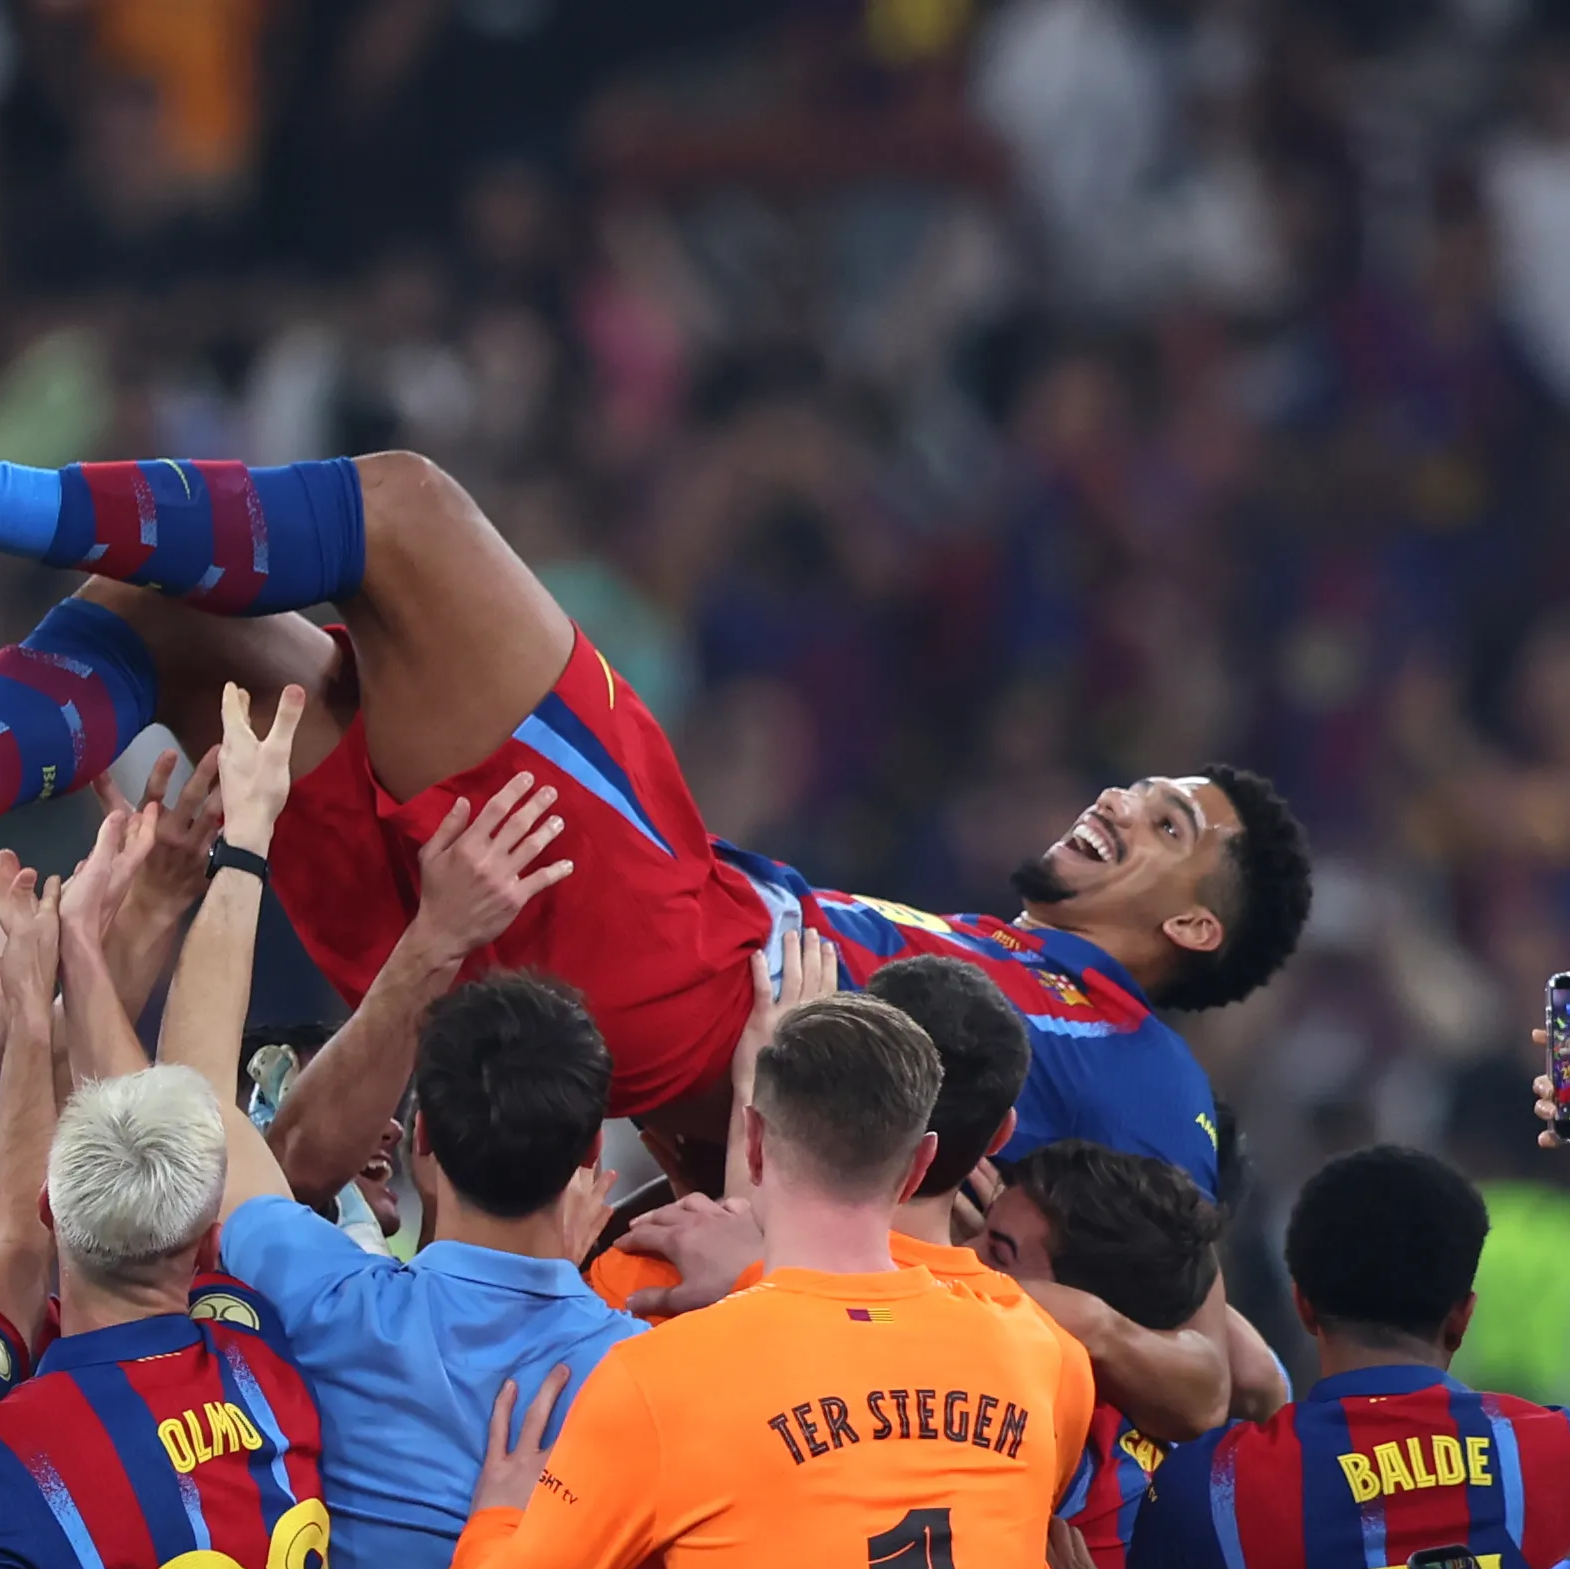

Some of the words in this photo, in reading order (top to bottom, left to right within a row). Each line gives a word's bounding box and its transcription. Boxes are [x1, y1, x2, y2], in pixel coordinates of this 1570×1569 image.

[157, 1402, 262, 1474] OLMO
[767, 1397, 860, 1465] TER
[869, 1389, 1029, 1459] STEGEN
[1337, 1436, 1493, 1504] BALDE
